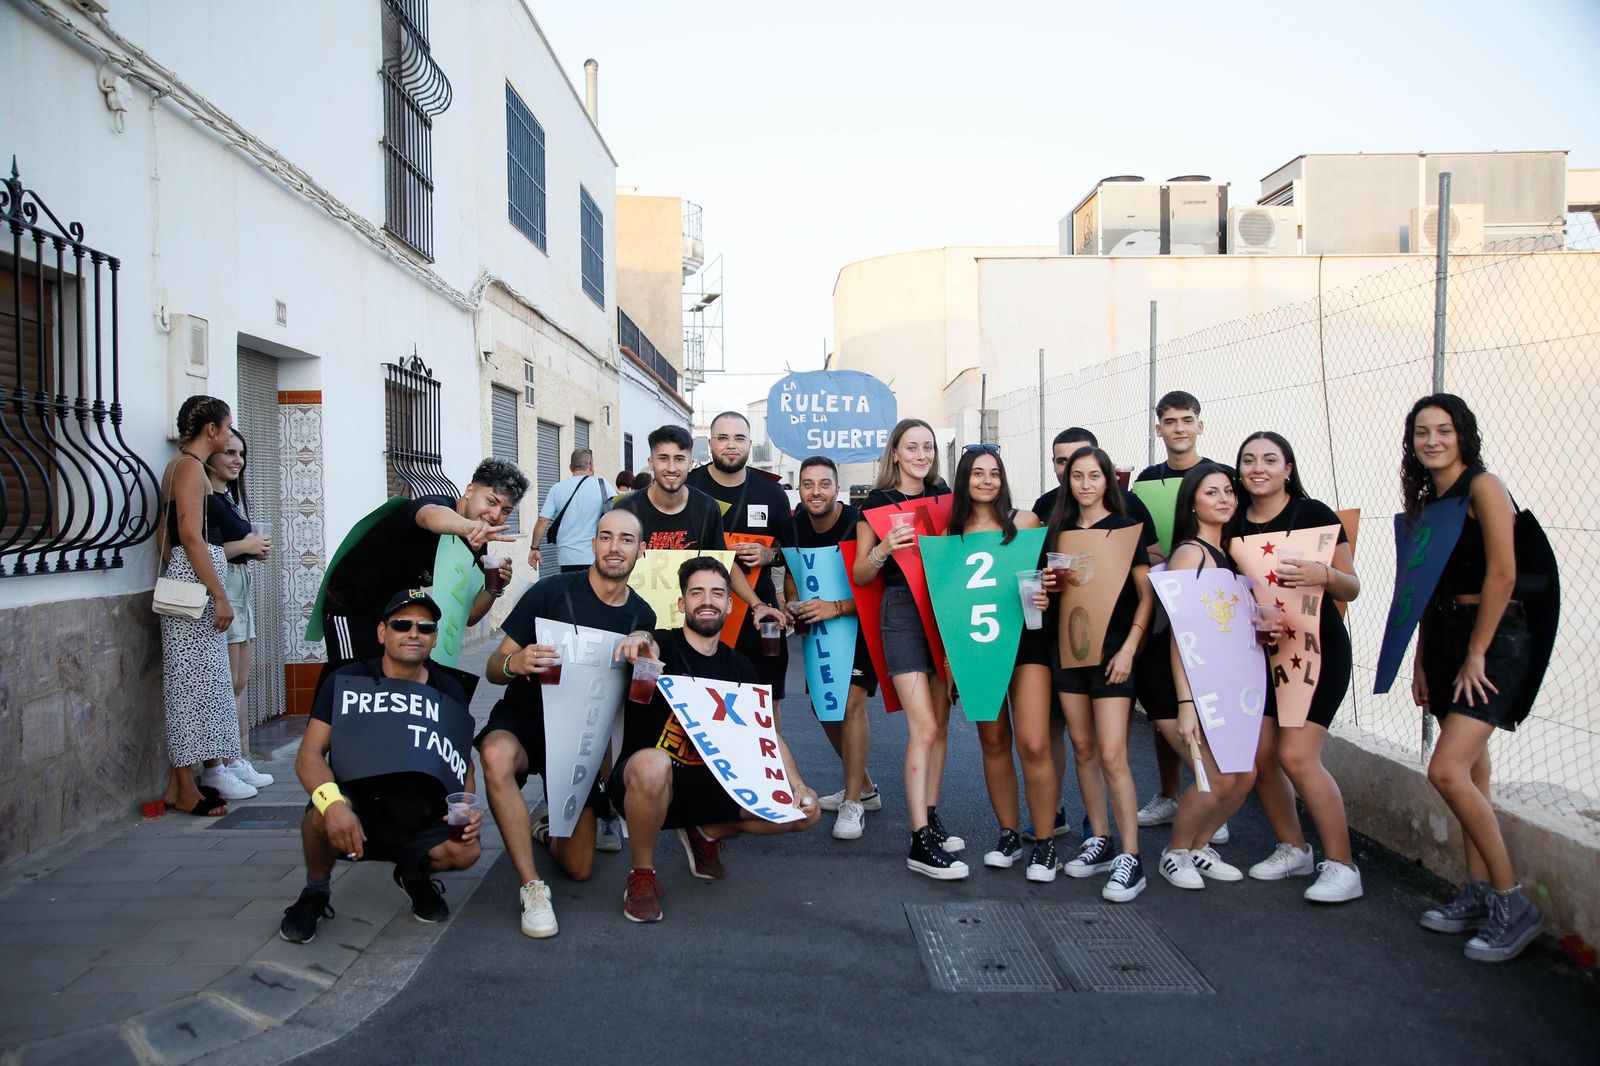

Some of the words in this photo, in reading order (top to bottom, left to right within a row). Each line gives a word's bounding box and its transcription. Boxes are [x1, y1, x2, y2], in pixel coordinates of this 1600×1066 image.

[780, 392, 870, 413] RULETA
[783, 381, 797, 391] LA
[790, 413, 806, 424] DE
[812, 413, 828, 423] LA
[806, 428, 888, 450] SUERTE
[965, 551, 1000, 643] 25
[1301, 532, 1336, 688] FNAL
[802, 553, 838, 711] VOALES
[341, 690, 439, 722] PRESEN
[407, 724, 467, 786] TADOR
[658, 677, 787, 820] PIERDE
[752, 686, 793, 804] TURNO
